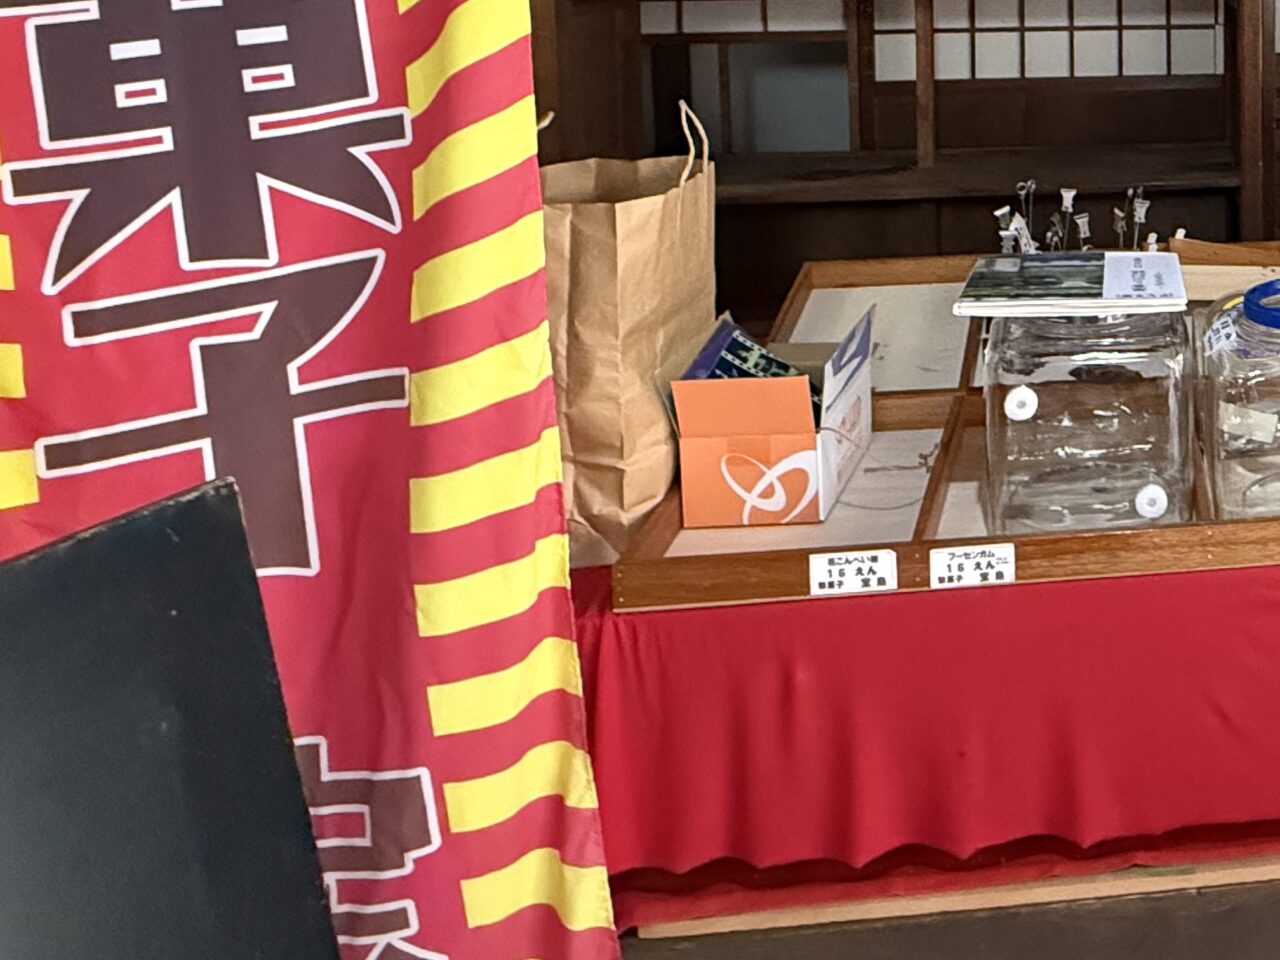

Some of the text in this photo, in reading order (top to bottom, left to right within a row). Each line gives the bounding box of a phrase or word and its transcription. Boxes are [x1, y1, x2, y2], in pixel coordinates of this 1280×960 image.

[947, 550, 995, 561] フーセンガム
